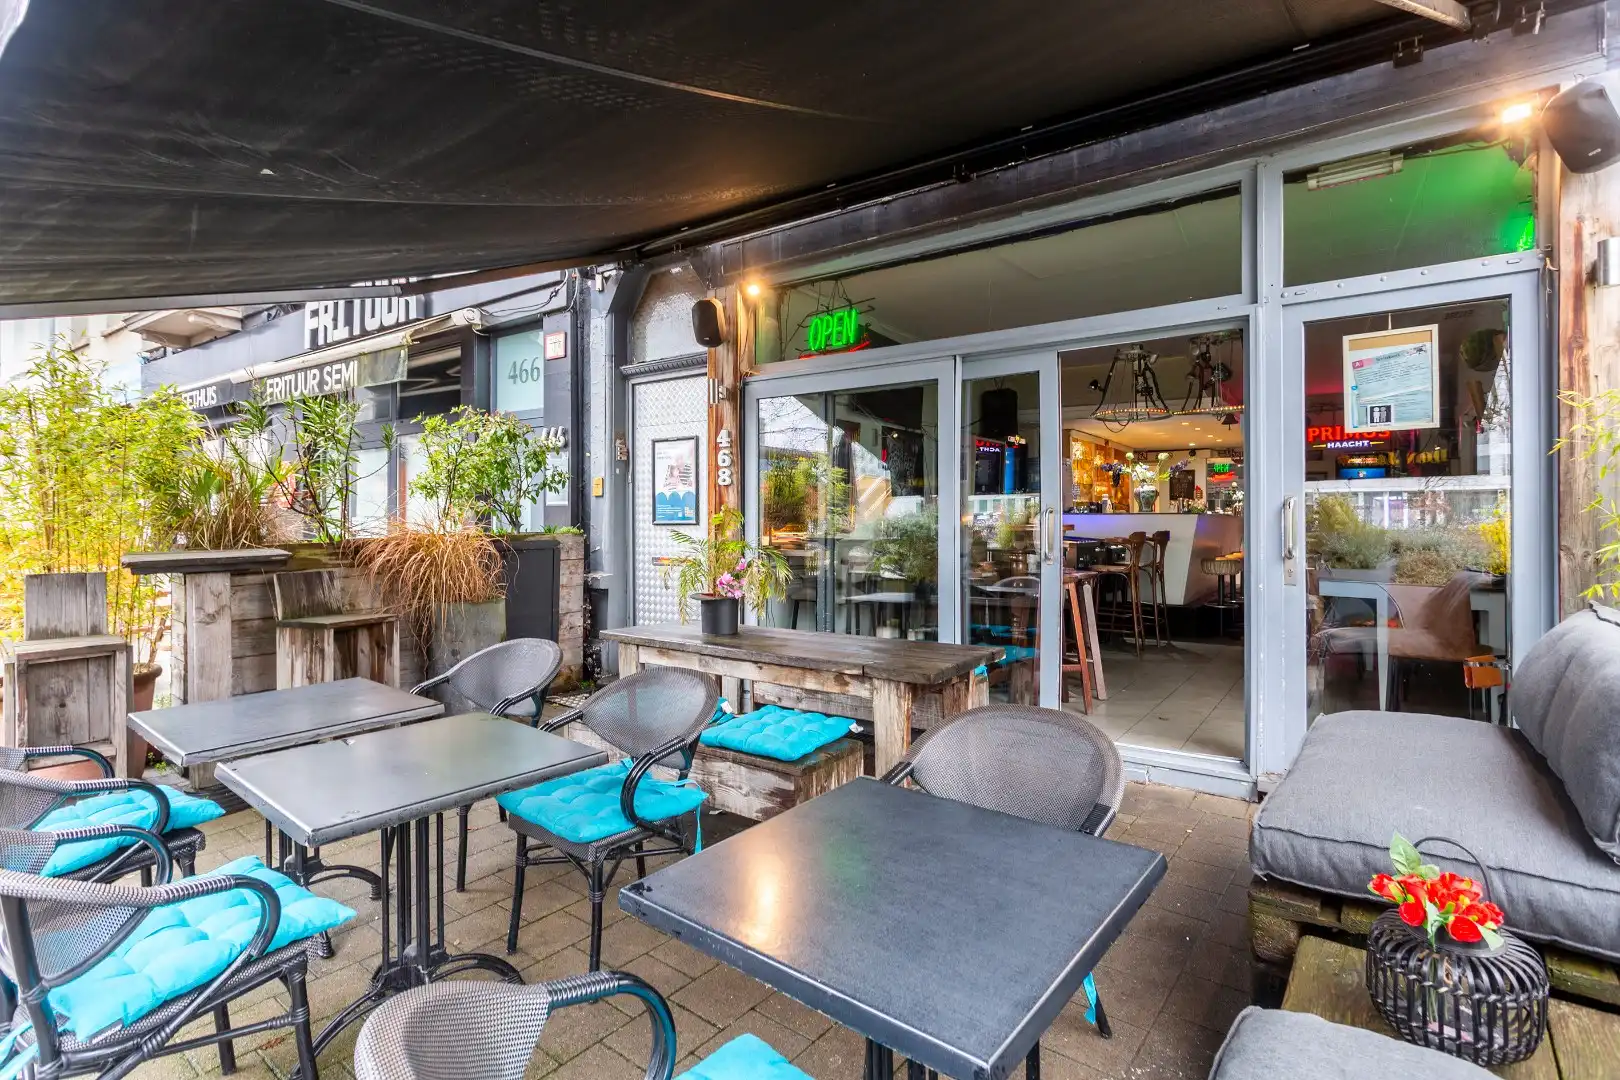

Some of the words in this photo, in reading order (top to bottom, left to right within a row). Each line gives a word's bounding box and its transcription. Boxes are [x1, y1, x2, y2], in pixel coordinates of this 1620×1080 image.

[809, 308, 857, 352] OPEN
[266, 369, 320, 402] FRITUUR
[323, 360, 359, 391] SEMI
[508, 357, 541, 385] 466
[717, 429, 732, 486] 468
[1327, 441, 1370, 449] HAACHT
